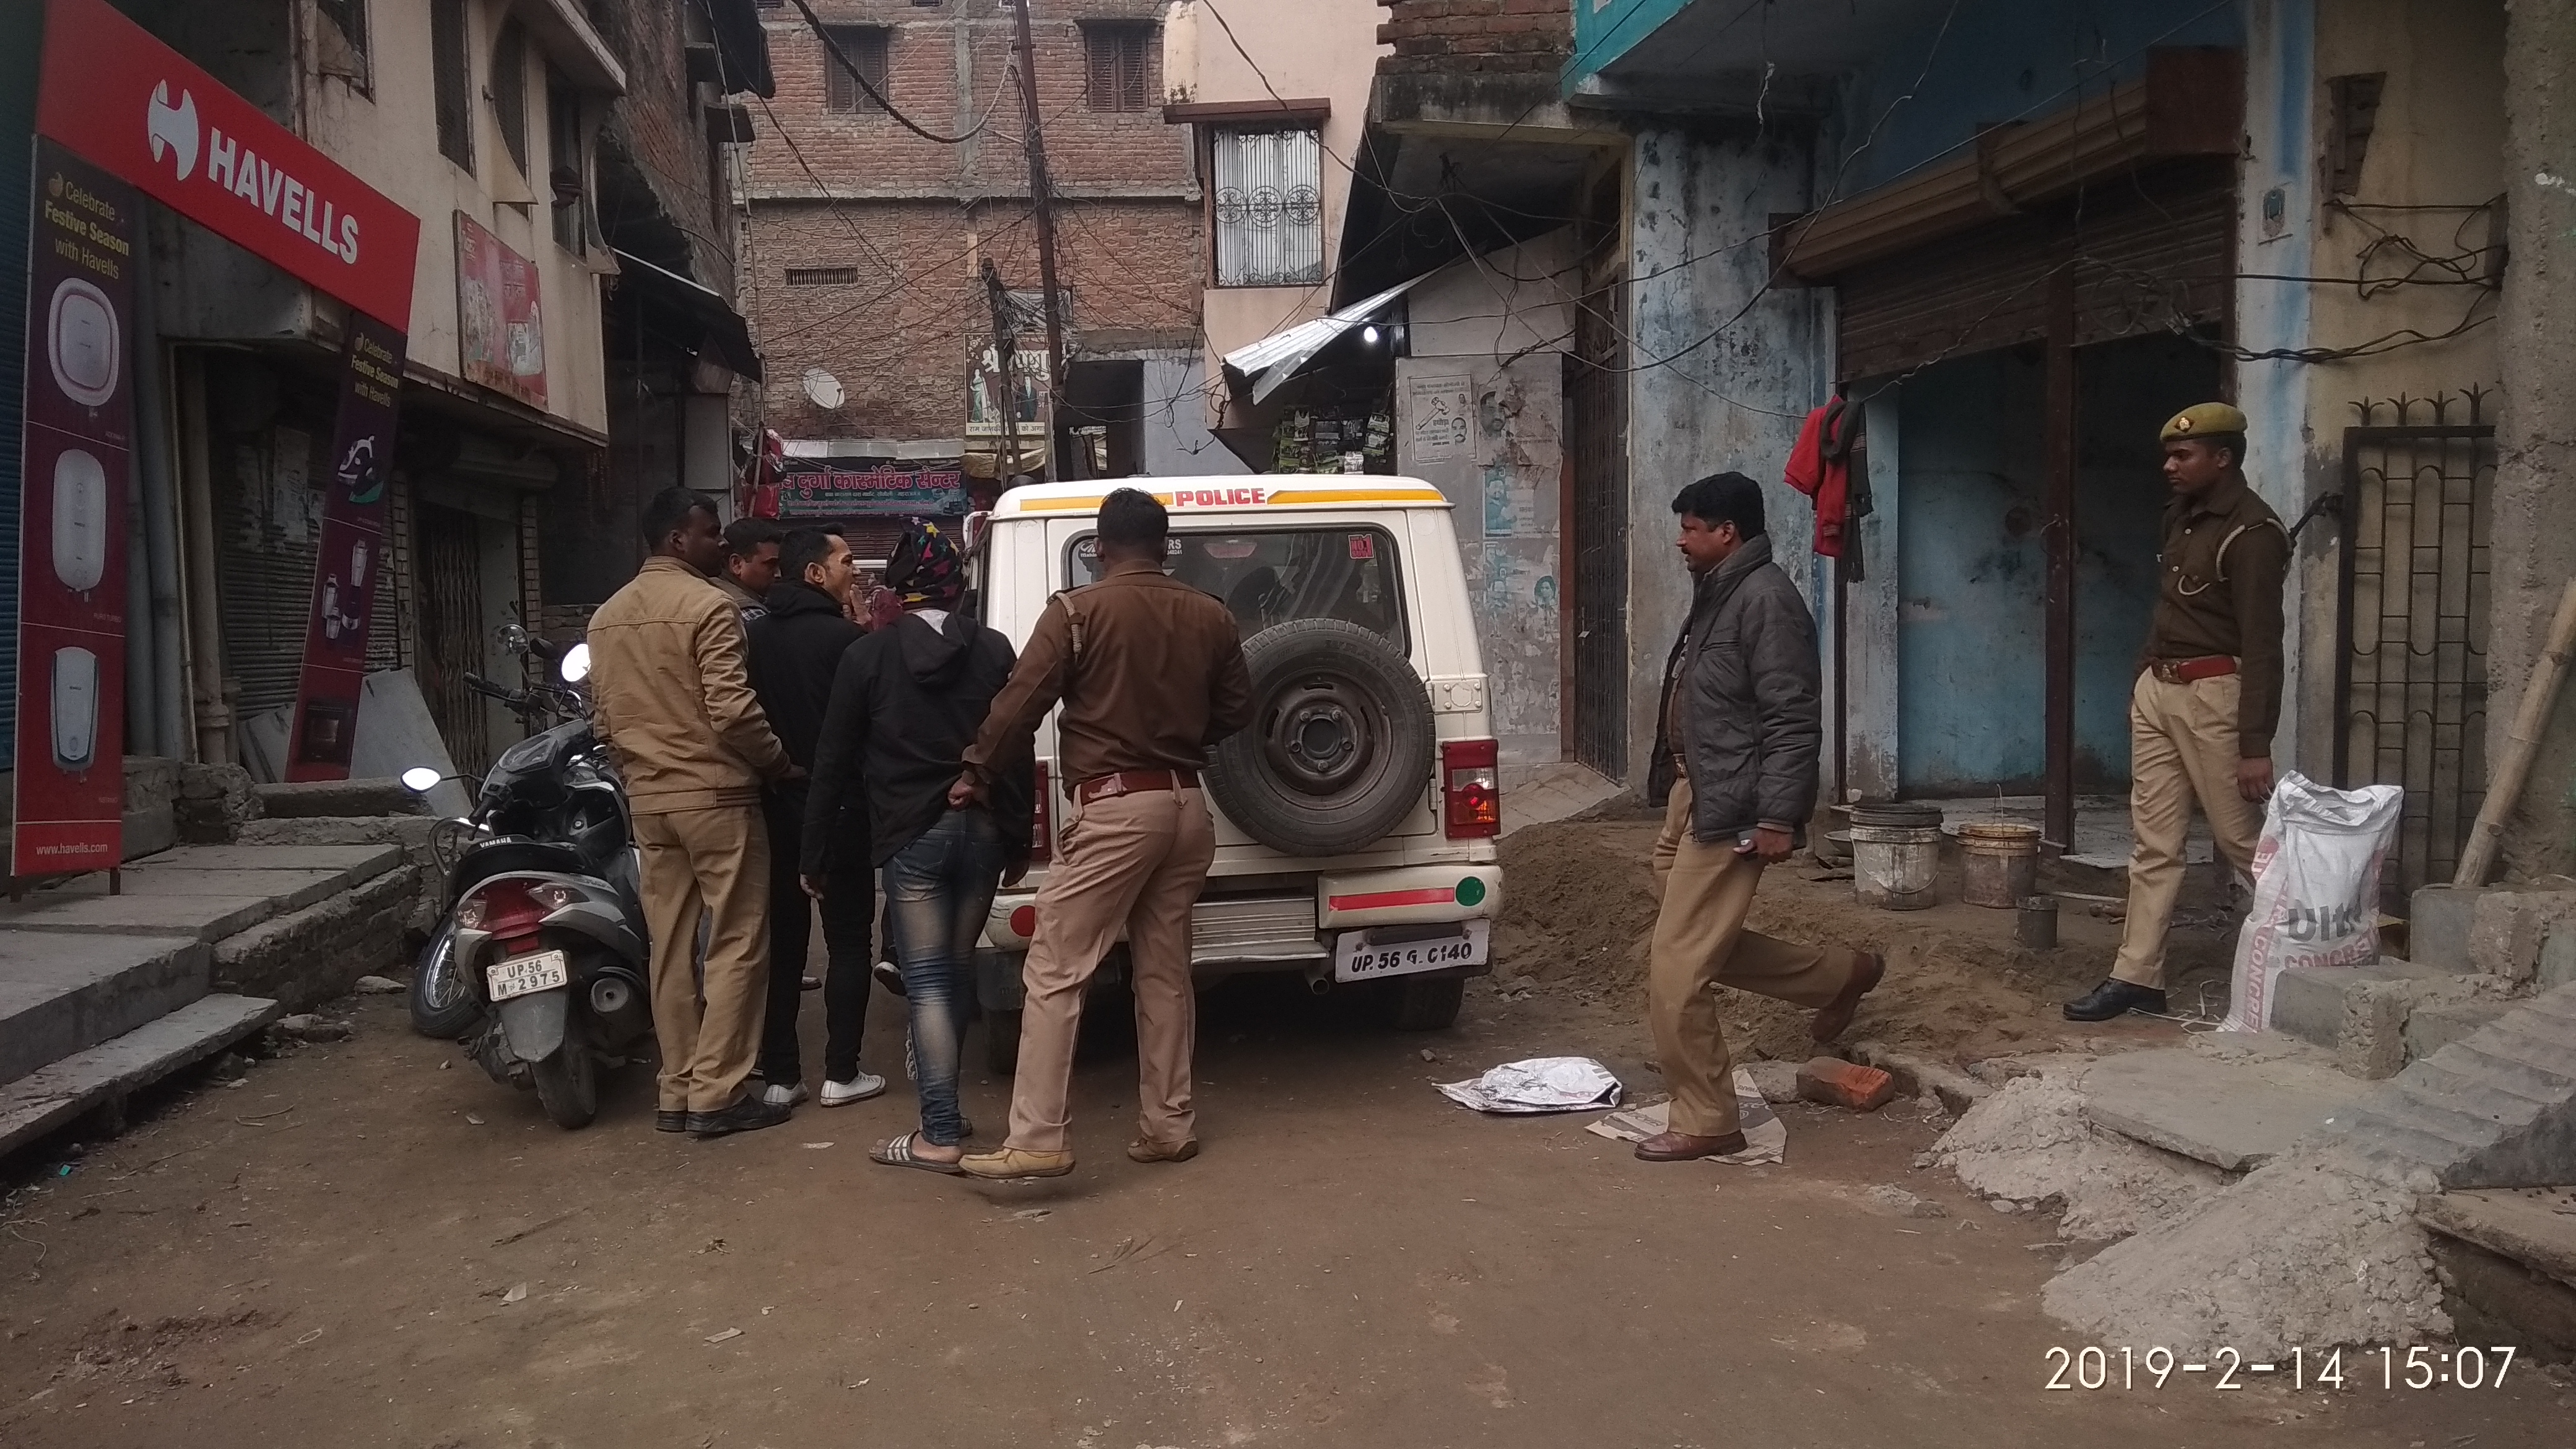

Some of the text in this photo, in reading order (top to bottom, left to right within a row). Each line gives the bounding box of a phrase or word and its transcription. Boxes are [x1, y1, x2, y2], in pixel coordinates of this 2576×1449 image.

[66, 181, 115, 221] Celebrate
[208, 127, 359, 265] HAVELLS
[45, 200, 129, 256] Festive Season
[55, 238, 119, 279] with Havells
[364, 338, 393, 364] Celebrate
[351, 354, 399, 389] Festive Season
[355, 381, 391, 407] with Havells
[796, 465, 831, 499] दुर्गा
[1175, 488, 1266, 507] POLICE
[1168, 539, 1181, 549] RS
[36, 842, 108, 855] www.havells.com
[479, 837, 512, 848] YAMAHA
[2247, 934, 2267, 1029] CONCRE
